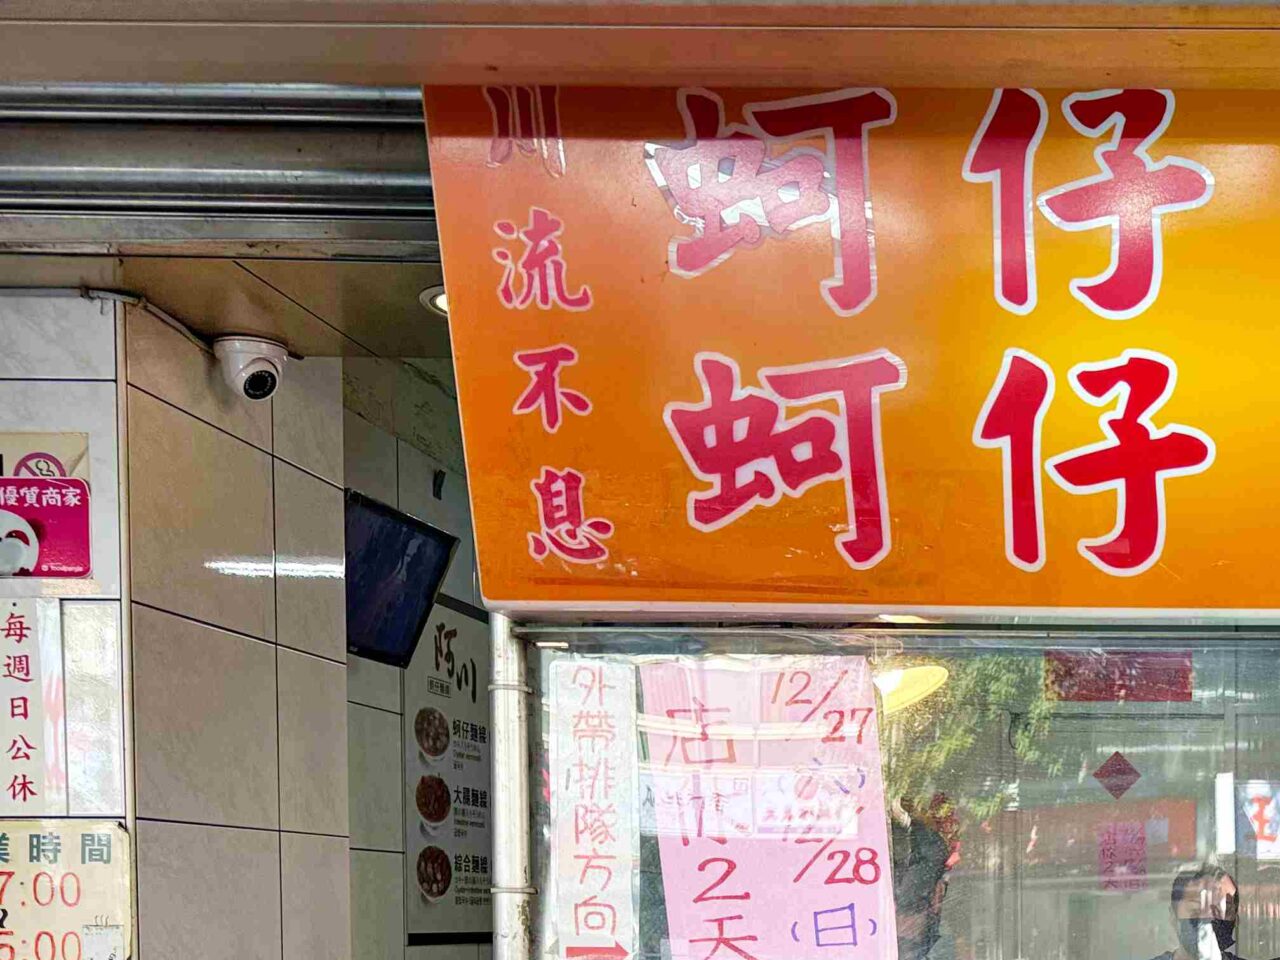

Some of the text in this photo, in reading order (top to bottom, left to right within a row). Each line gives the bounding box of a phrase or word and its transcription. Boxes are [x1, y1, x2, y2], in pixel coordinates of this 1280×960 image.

[1, 611, 38, 803] 每週日公休
[790, 902, 878, 948] (日)
